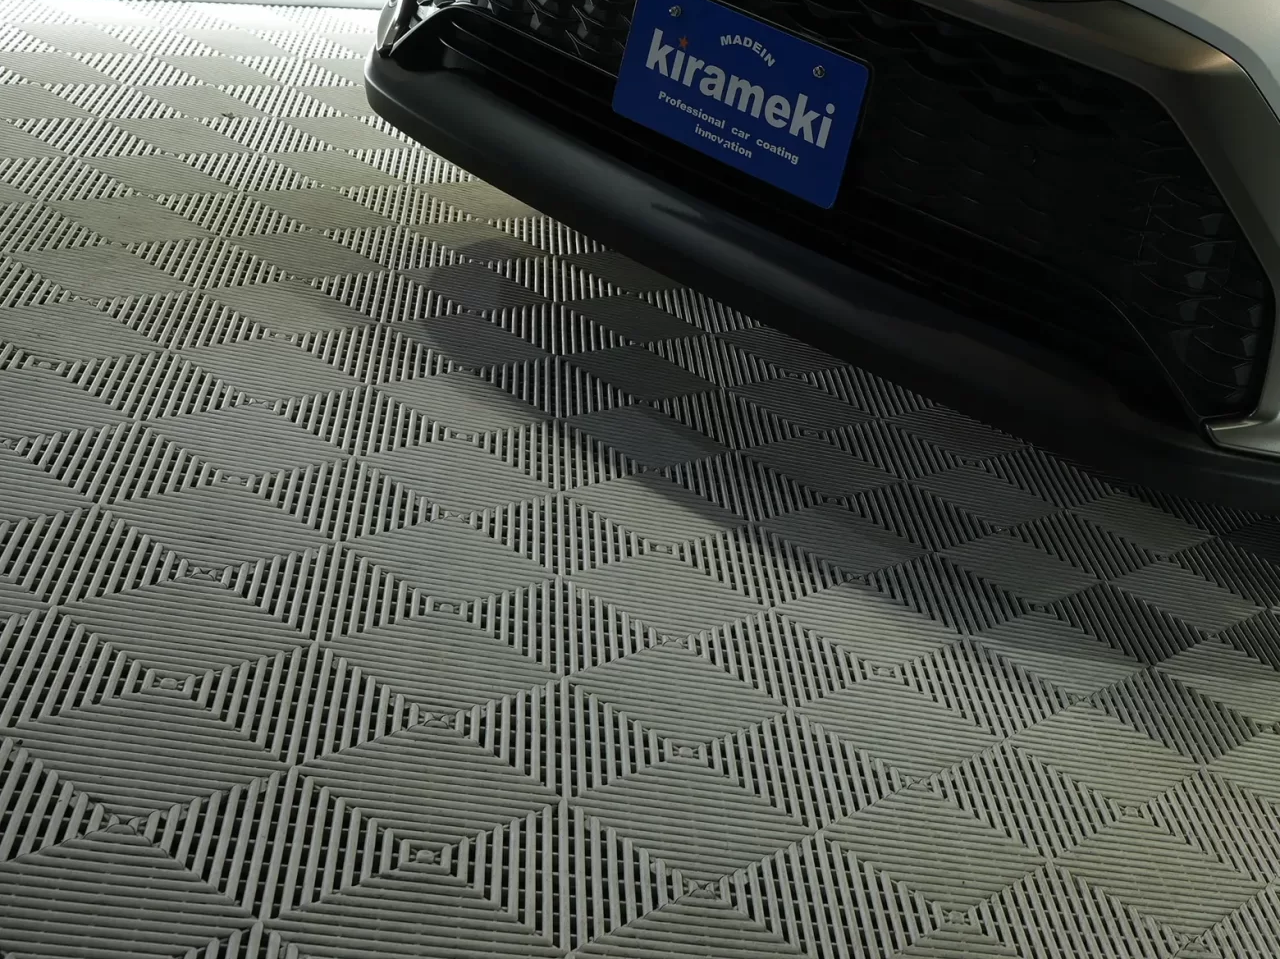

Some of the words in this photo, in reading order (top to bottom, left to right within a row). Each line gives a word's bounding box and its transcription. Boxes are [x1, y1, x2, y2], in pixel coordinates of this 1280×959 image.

[645, 28, 836, 149] kirameki
[658, 91, 726, 129] Professional
[731, 126, 751, 140] car
[756, 139, 800, 165] coating
[694, 124, 753, 159] innovation
